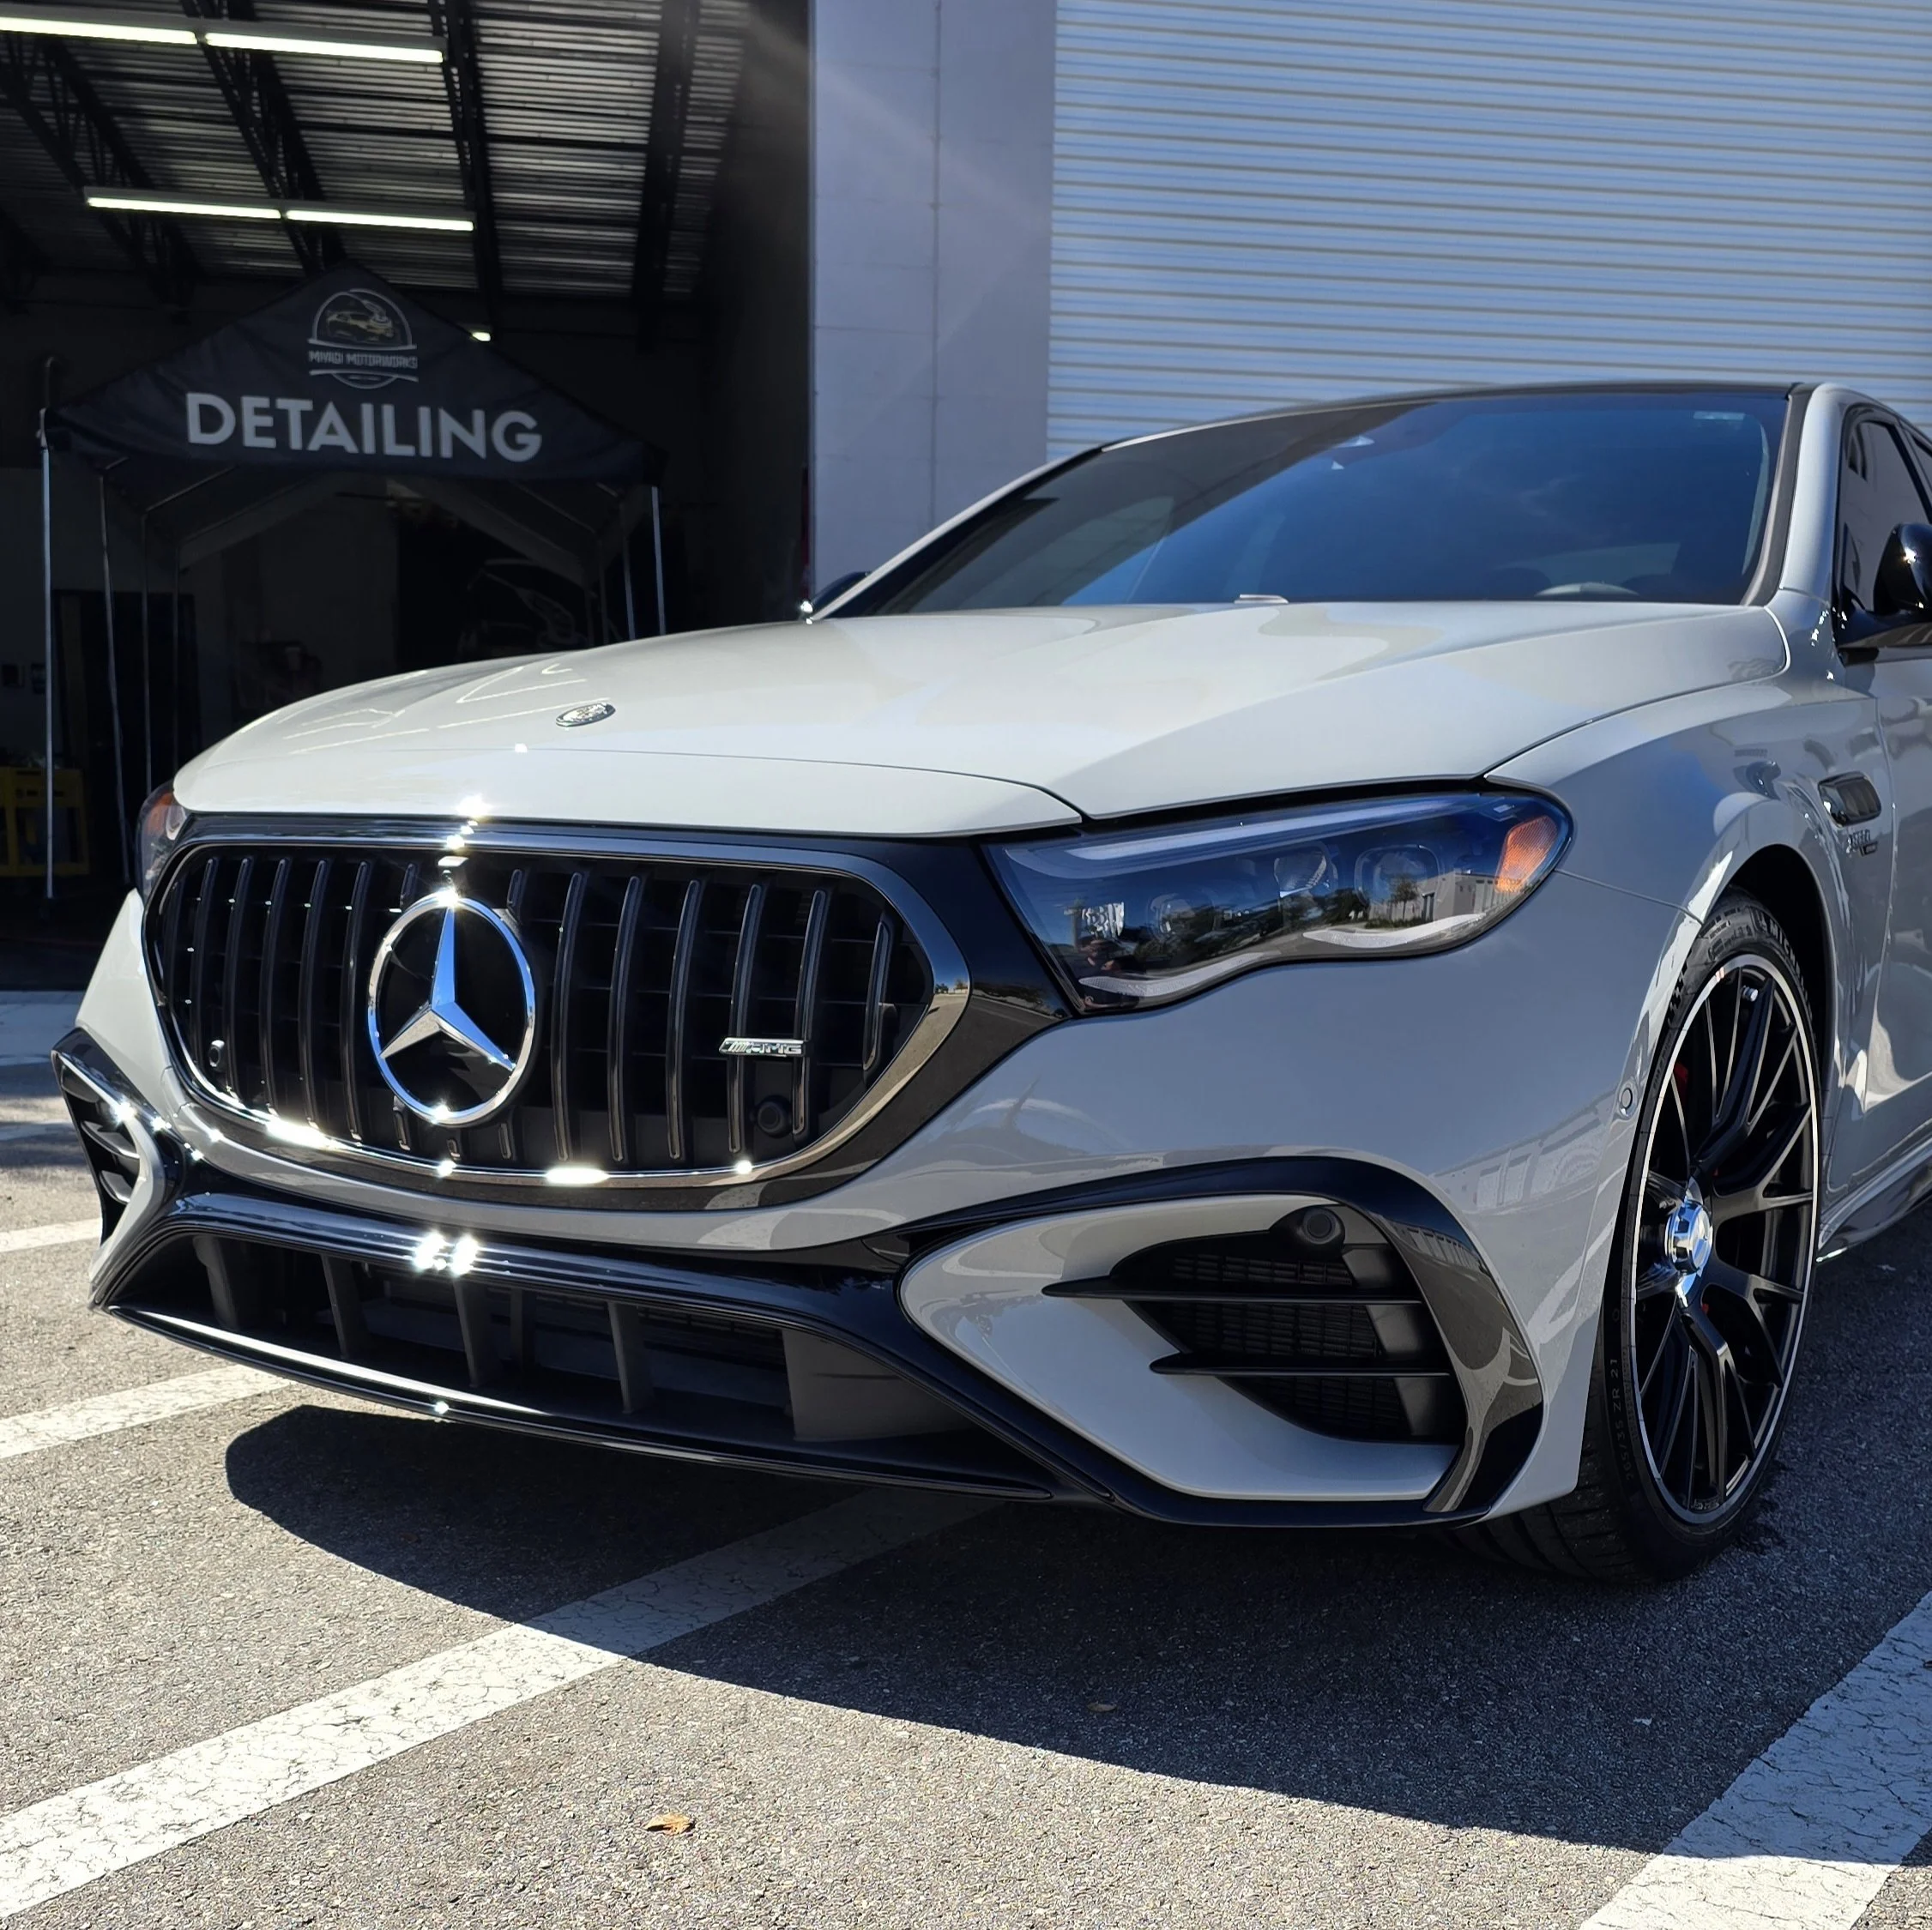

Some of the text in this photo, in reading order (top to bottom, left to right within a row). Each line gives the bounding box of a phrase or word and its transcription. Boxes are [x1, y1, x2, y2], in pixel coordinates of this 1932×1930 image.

[346, 353, 419, 370] MOTORWORKS
[185, 392, 542, 463] DETAILING
[1609, 1358, 1618, 1378] 21
[1612, 1387, 1621, 1413] ZR
